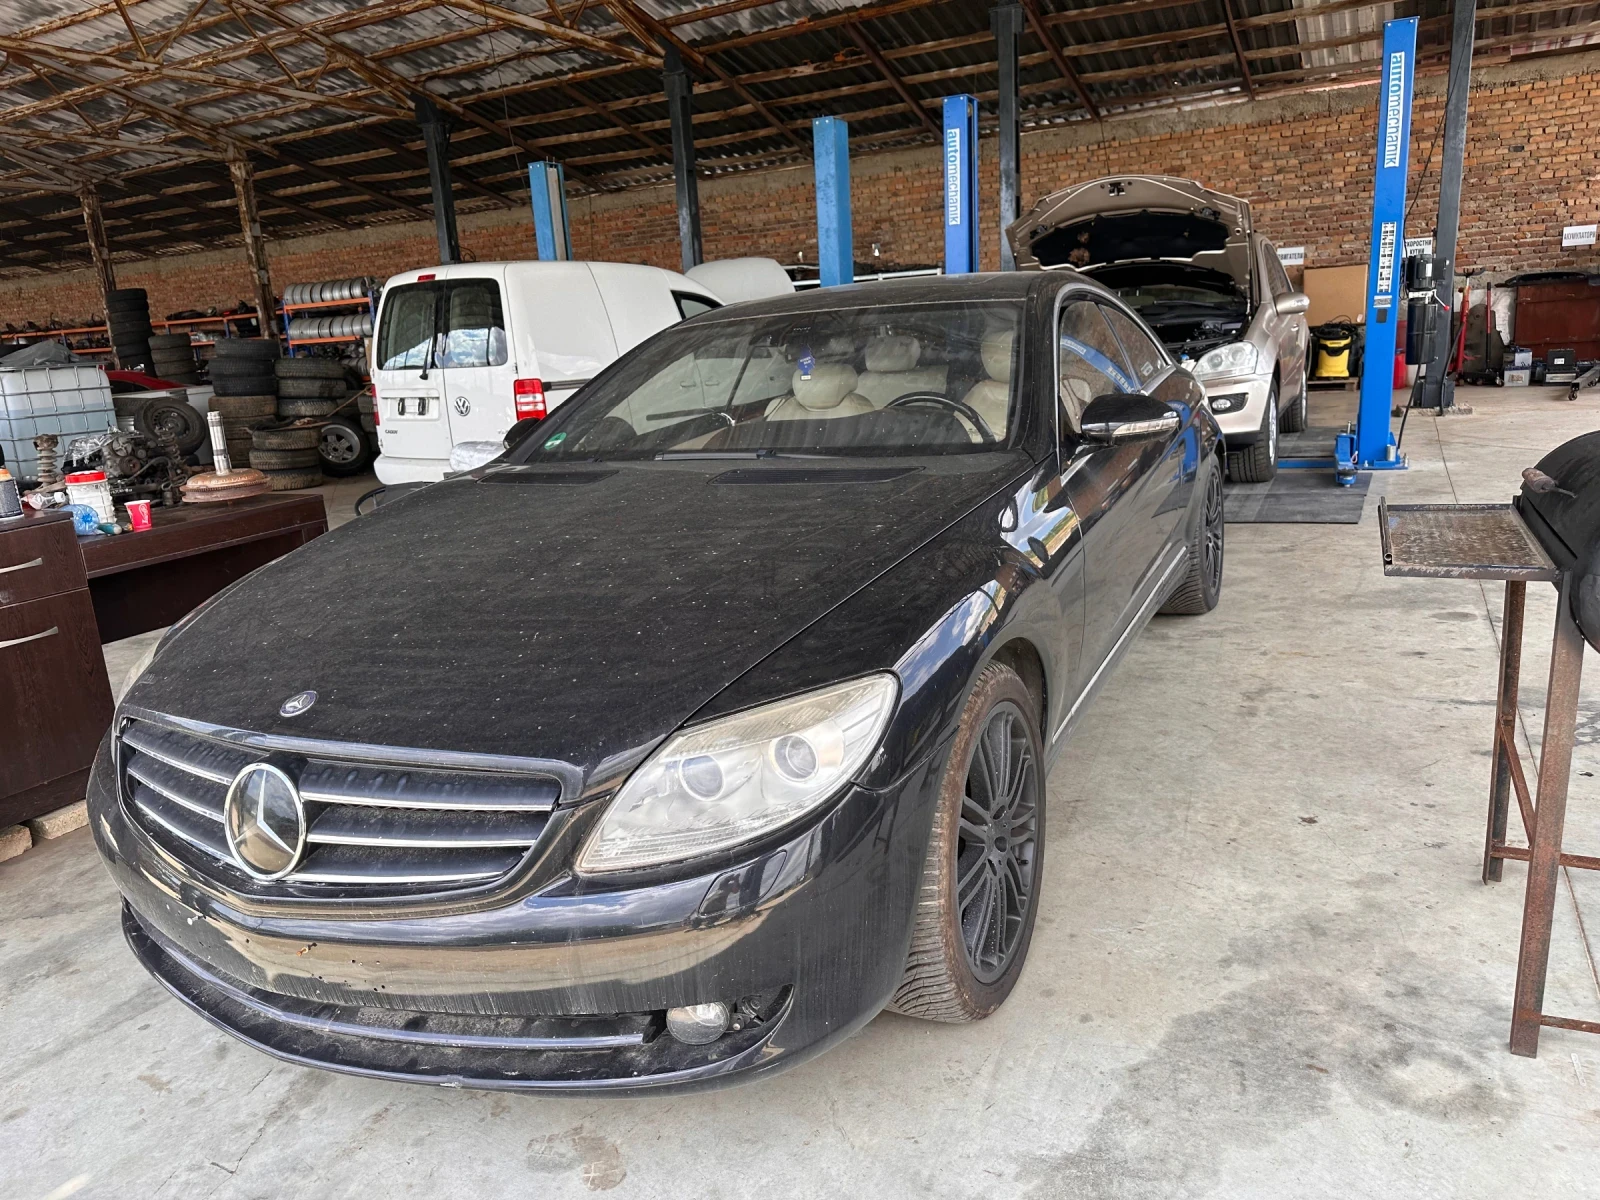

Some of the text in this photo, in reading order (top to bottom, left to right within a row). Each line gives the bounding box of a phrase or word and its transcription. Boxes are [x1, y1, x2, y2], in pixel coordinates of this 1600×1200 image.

[1386, 55, 1402, 165] automechanik
[948, 131, 959, 223] automechanik
[1405, 239, 1431, 248] КОРОСТНИ
